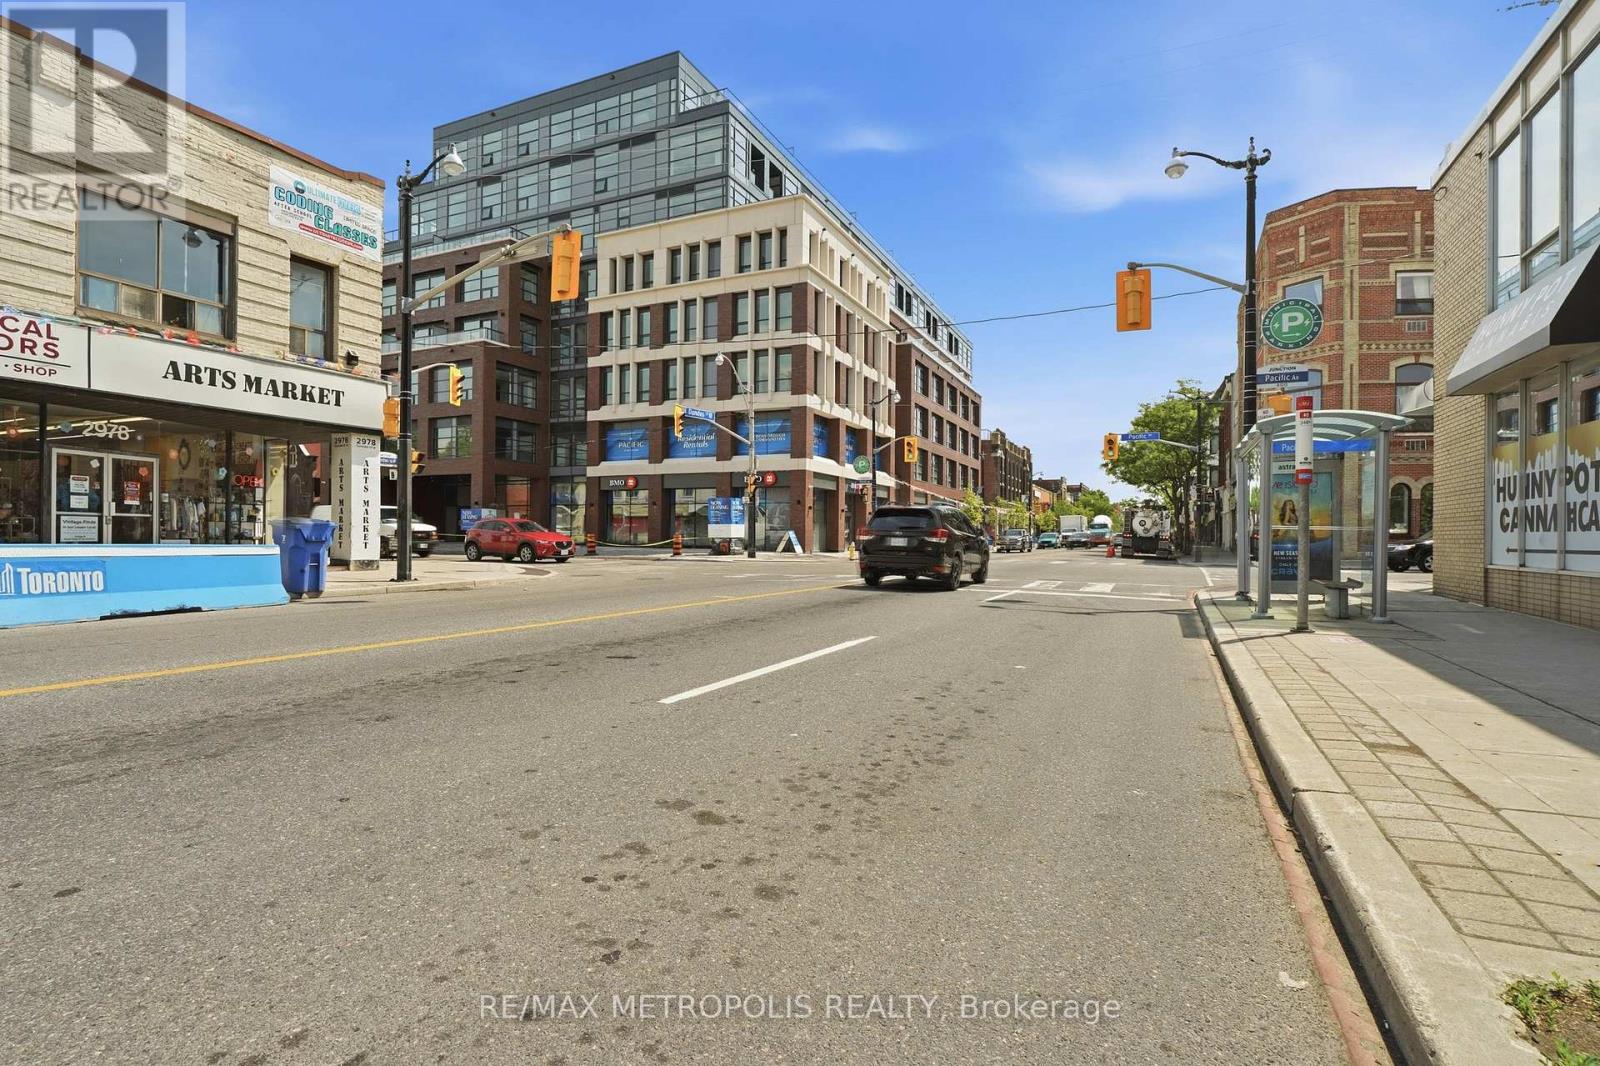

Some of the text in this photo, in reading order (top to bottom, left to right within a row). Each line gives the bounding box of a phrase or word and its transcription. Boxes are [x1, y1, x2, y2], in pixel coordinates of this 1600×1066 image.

[274, 186, 334, 220] CODING
[313, 214, 378, 249] CLASSES
[1265, 301, 1318, 325] MUNICIPAL
[1281, 312, 1304, 332] P
[0, 316, 59, 341] CAL
[1266, 326, 1319, 348] PARKING
[0, 334, 59, 359] ORS
[13, 364, 57, 376] SHOP
[1265, 374, 1290, 382] Pacific
[162, 360, 345, 407] ARTS MARKET
[688, 408, 705, 417] Dundas
[82, 420, 129, 440] 2978
[356, 438, 376, 446] 2978
[618, 441, 644, 449] PACIFIC
[683, 440, 709, 449] Rentals
[362, 459, 370, 550] ARTS MARKET
[17, 567, 104, 595] TORONTO
